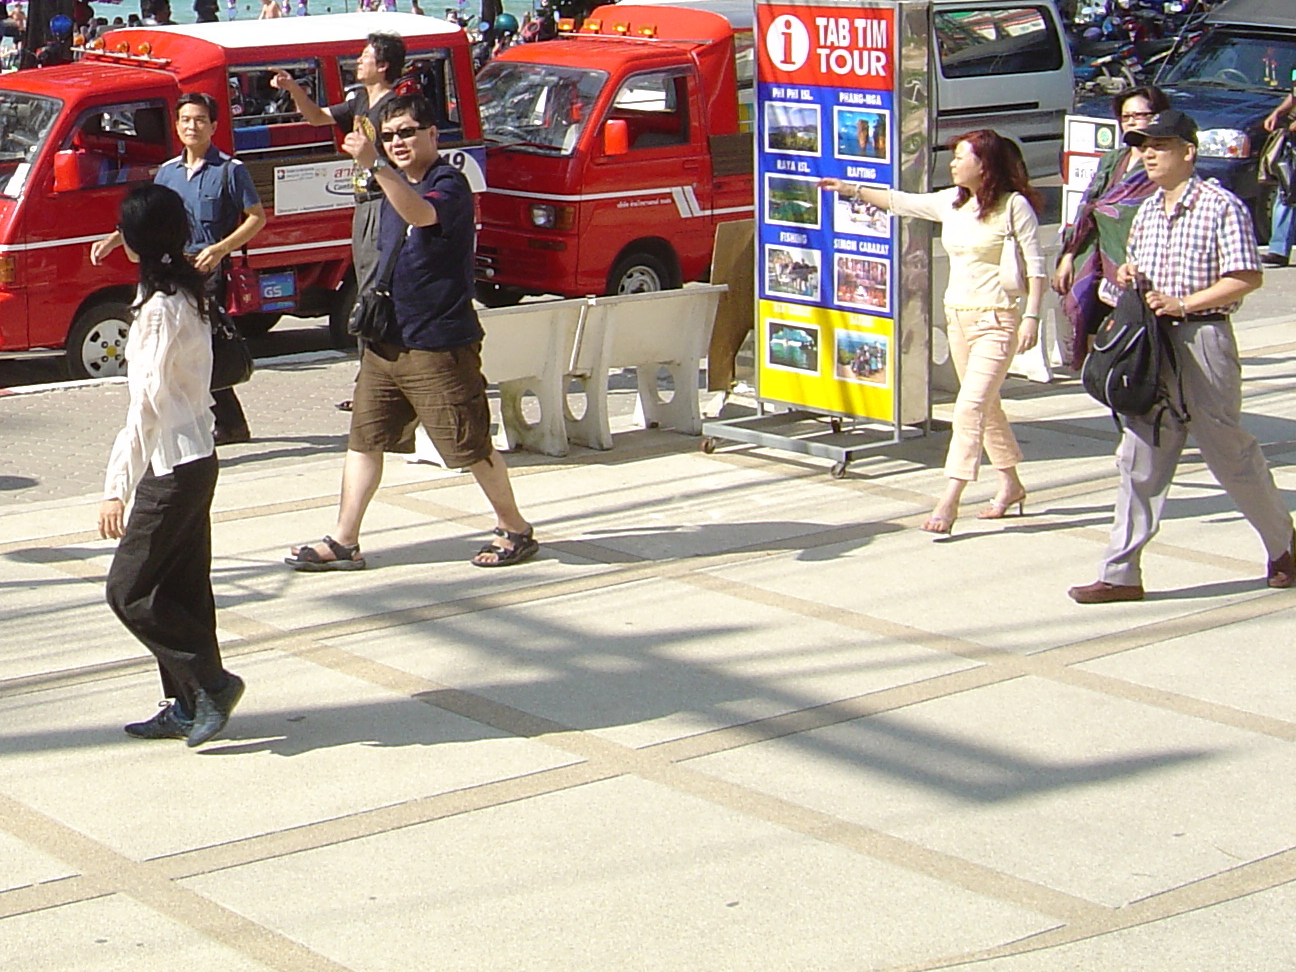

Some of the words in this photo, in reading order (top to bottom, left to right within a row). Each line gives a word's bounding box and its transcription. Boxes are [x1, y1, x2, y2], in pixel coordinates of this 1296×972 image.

[815, 17, 851, 47] TAB
[854, 19, 887, 48] TIM
[816, 48, 887, 76] TOUR
[264, 285, 282, 298] GS
